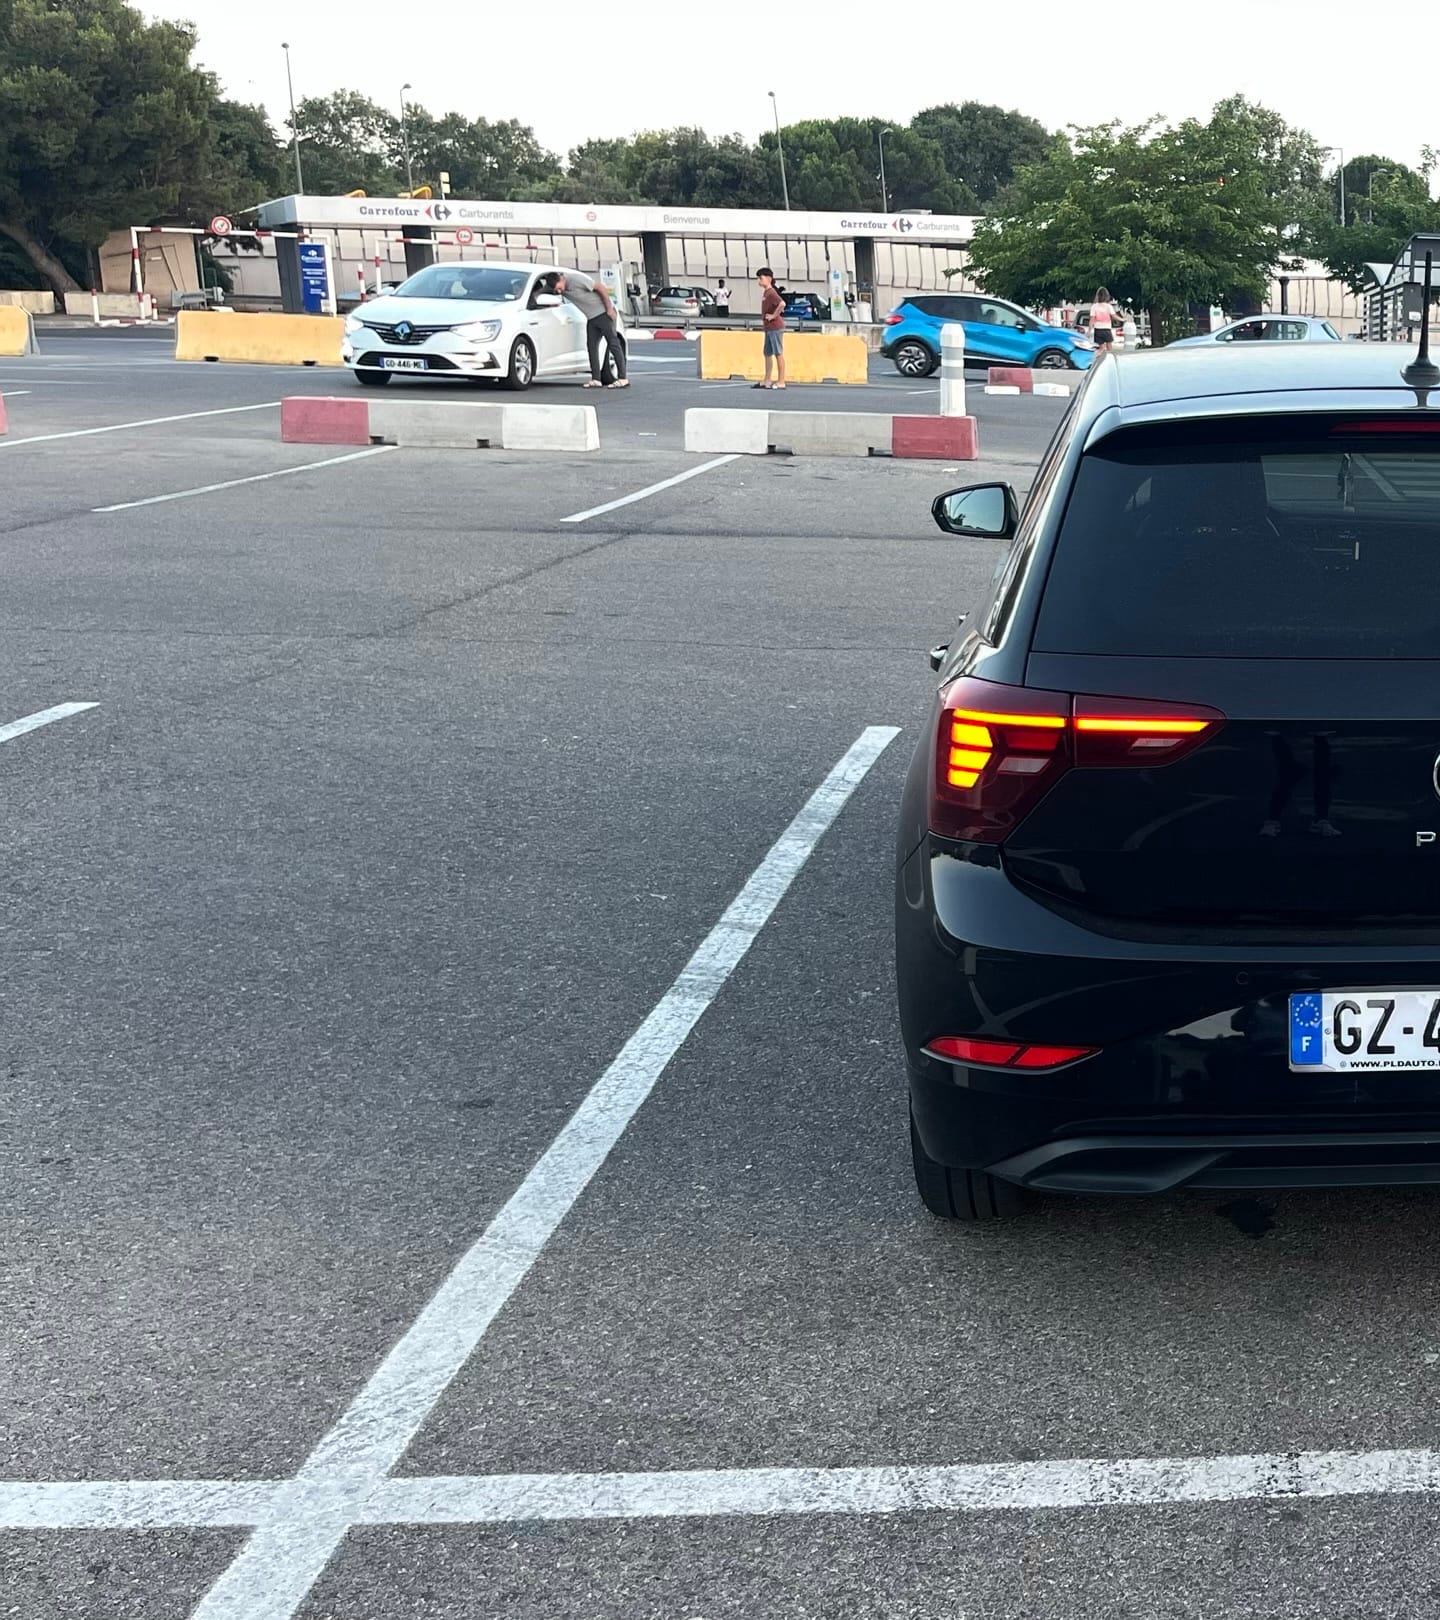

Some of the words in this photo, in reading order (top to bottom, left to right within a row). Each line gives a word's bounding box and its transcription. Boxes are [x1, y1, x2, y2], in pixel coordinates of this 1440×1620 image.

[359, 206, 420, 217] Carrefour
[459, 208, 514, 220] Carburants
[663, 214, 711, 225] Bienvenue
[840, 219, 888, 230] Carrefour
[916, 221, 960, 232] Carburants
[1301, 1035, 1313, 1052] F
